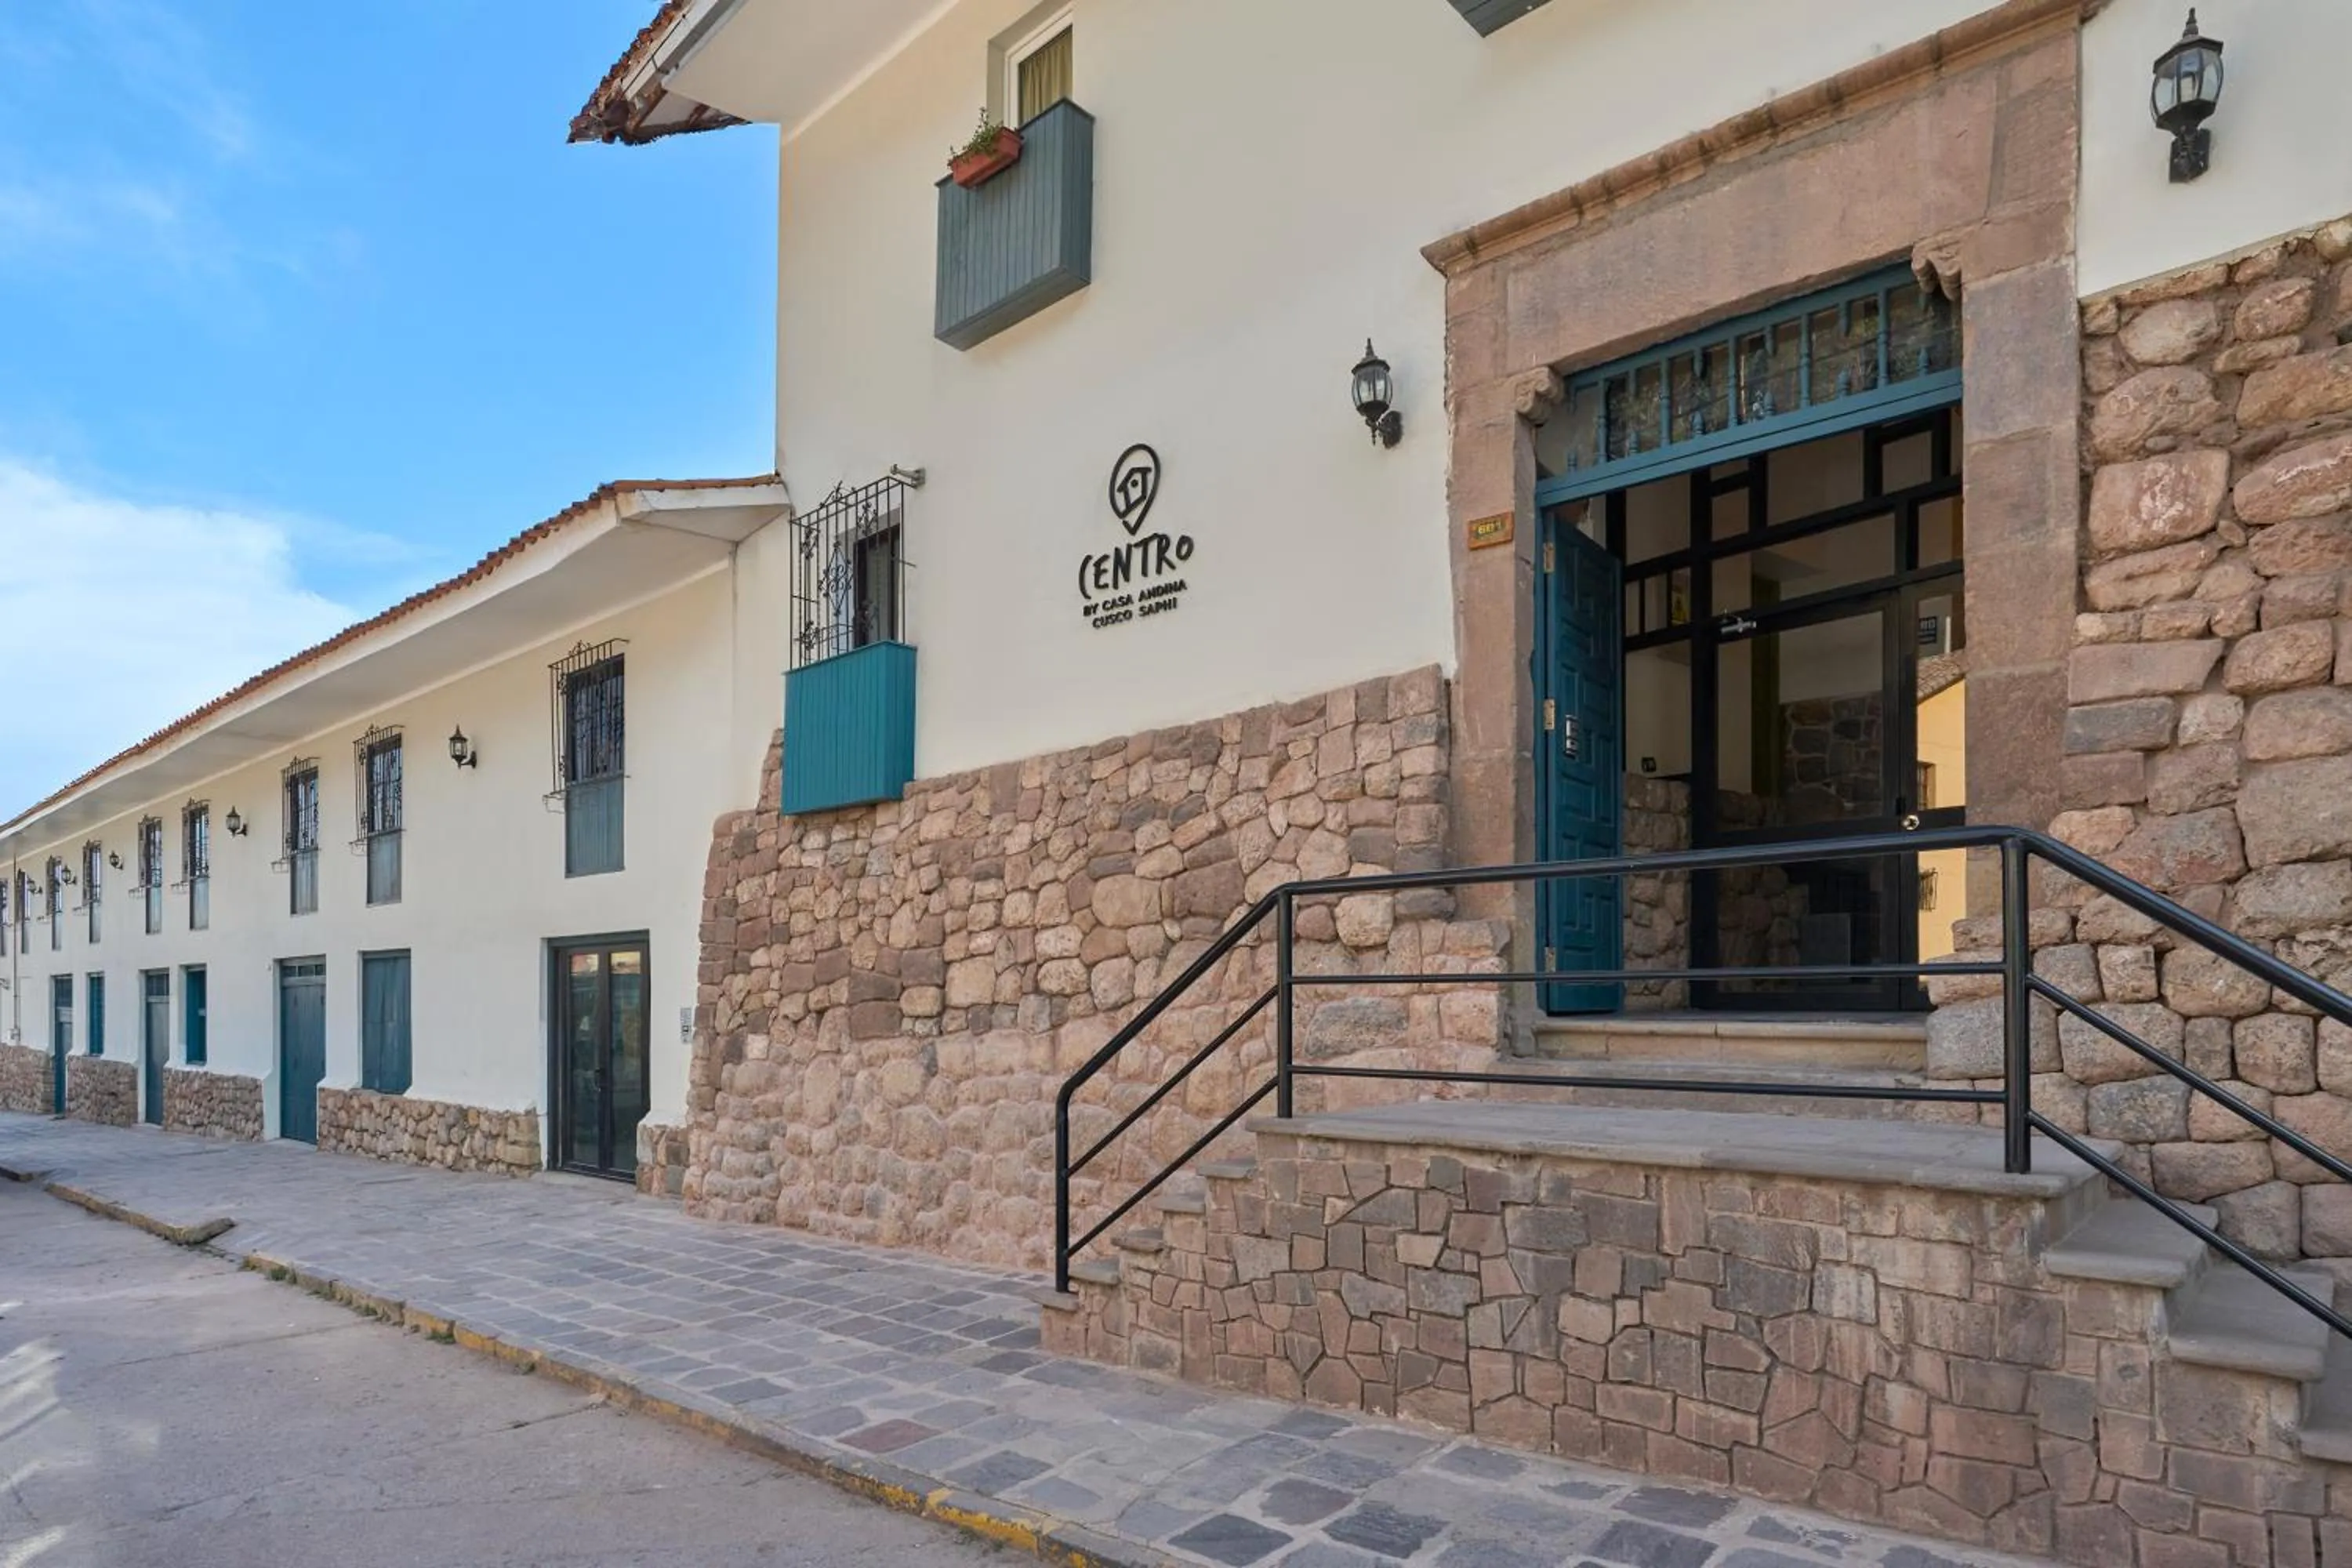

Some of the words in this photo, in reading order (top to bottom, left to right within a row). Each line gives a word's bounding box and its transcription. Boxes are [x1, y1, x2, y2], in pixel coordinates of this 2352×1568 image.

[1079, 533, 1193, 600] CENTRO
[1083, 603, 1098, 616] BY
[1102, 594, 1134, 611] CASA
[1139, 579, 1187, 601] ANDINA
[1093, 610, 1133, 629] CUSCO
[1139, 597, 1177, 616] SAPHI
